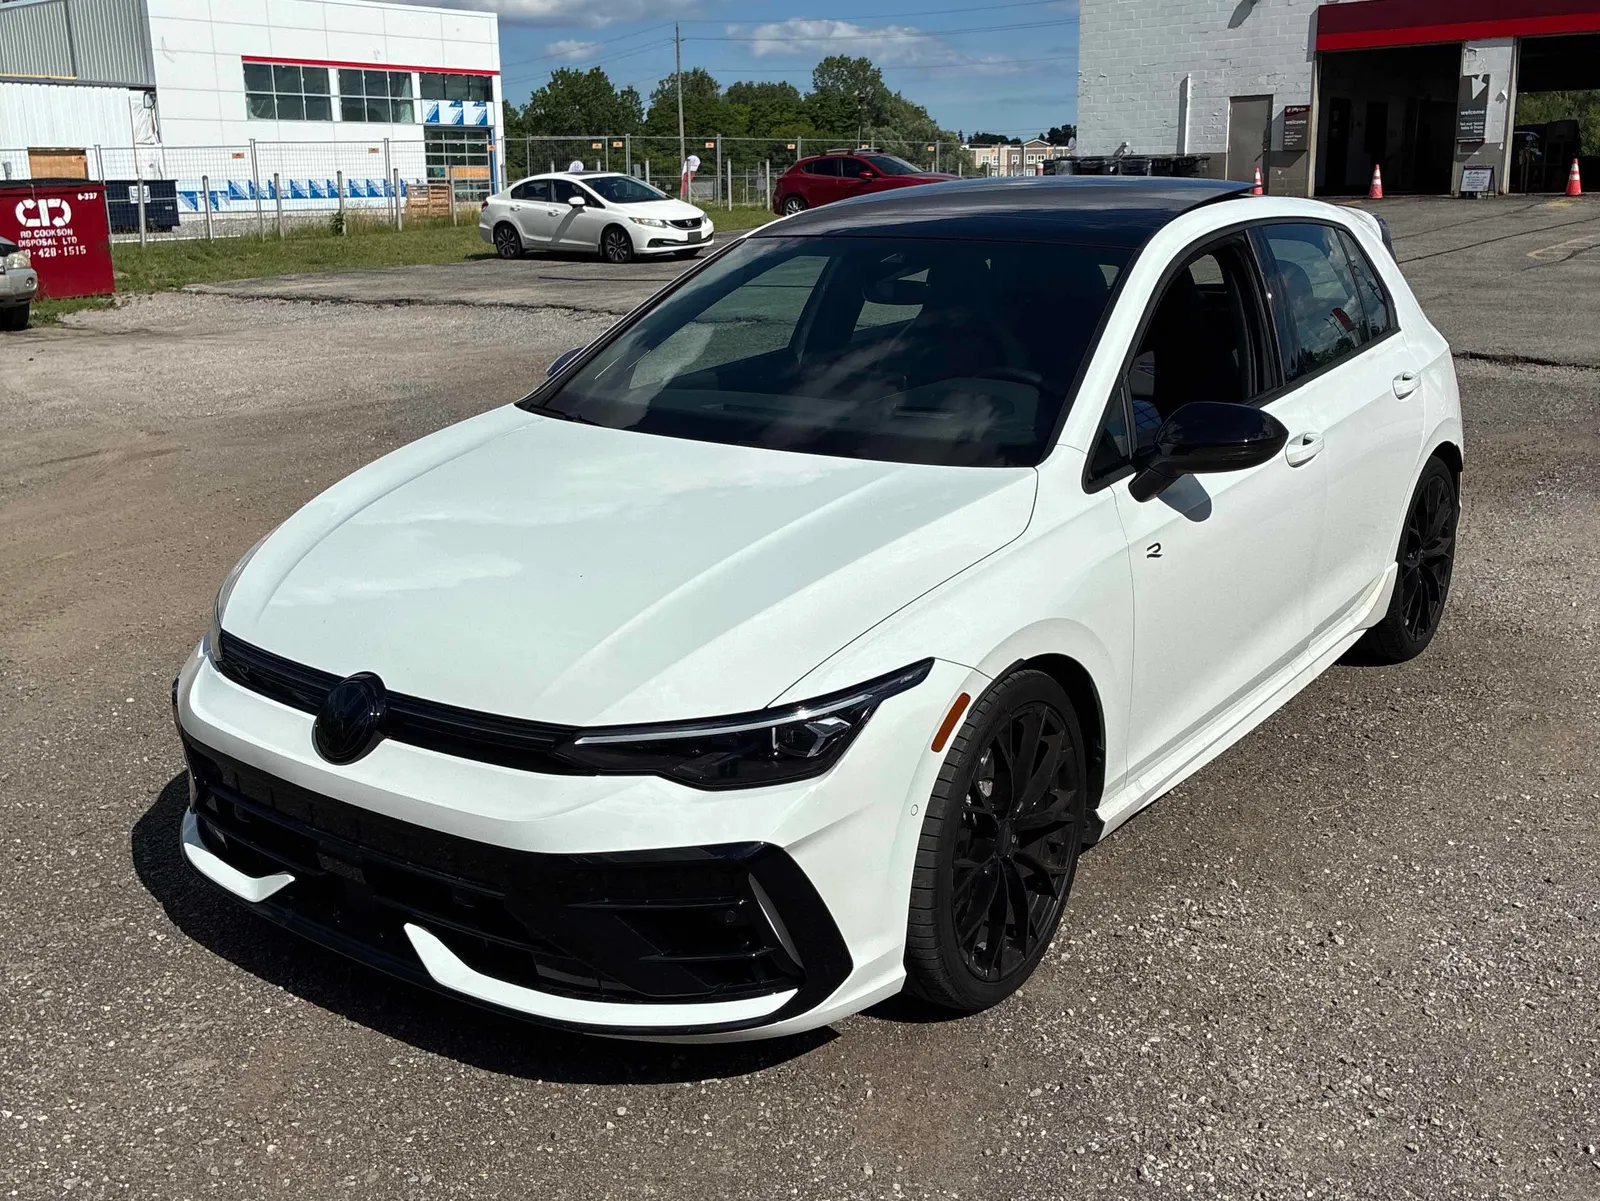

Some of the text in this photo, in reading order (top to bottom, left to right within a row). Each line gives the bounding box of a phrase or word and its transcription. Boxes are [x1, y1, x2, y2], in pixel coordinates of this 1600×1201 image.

[77, 192, 98, 201] 6-337
[20, 228, 73, 239] RD COOKSON
[18, 236, 78, 248] DISPOSAL LTD
